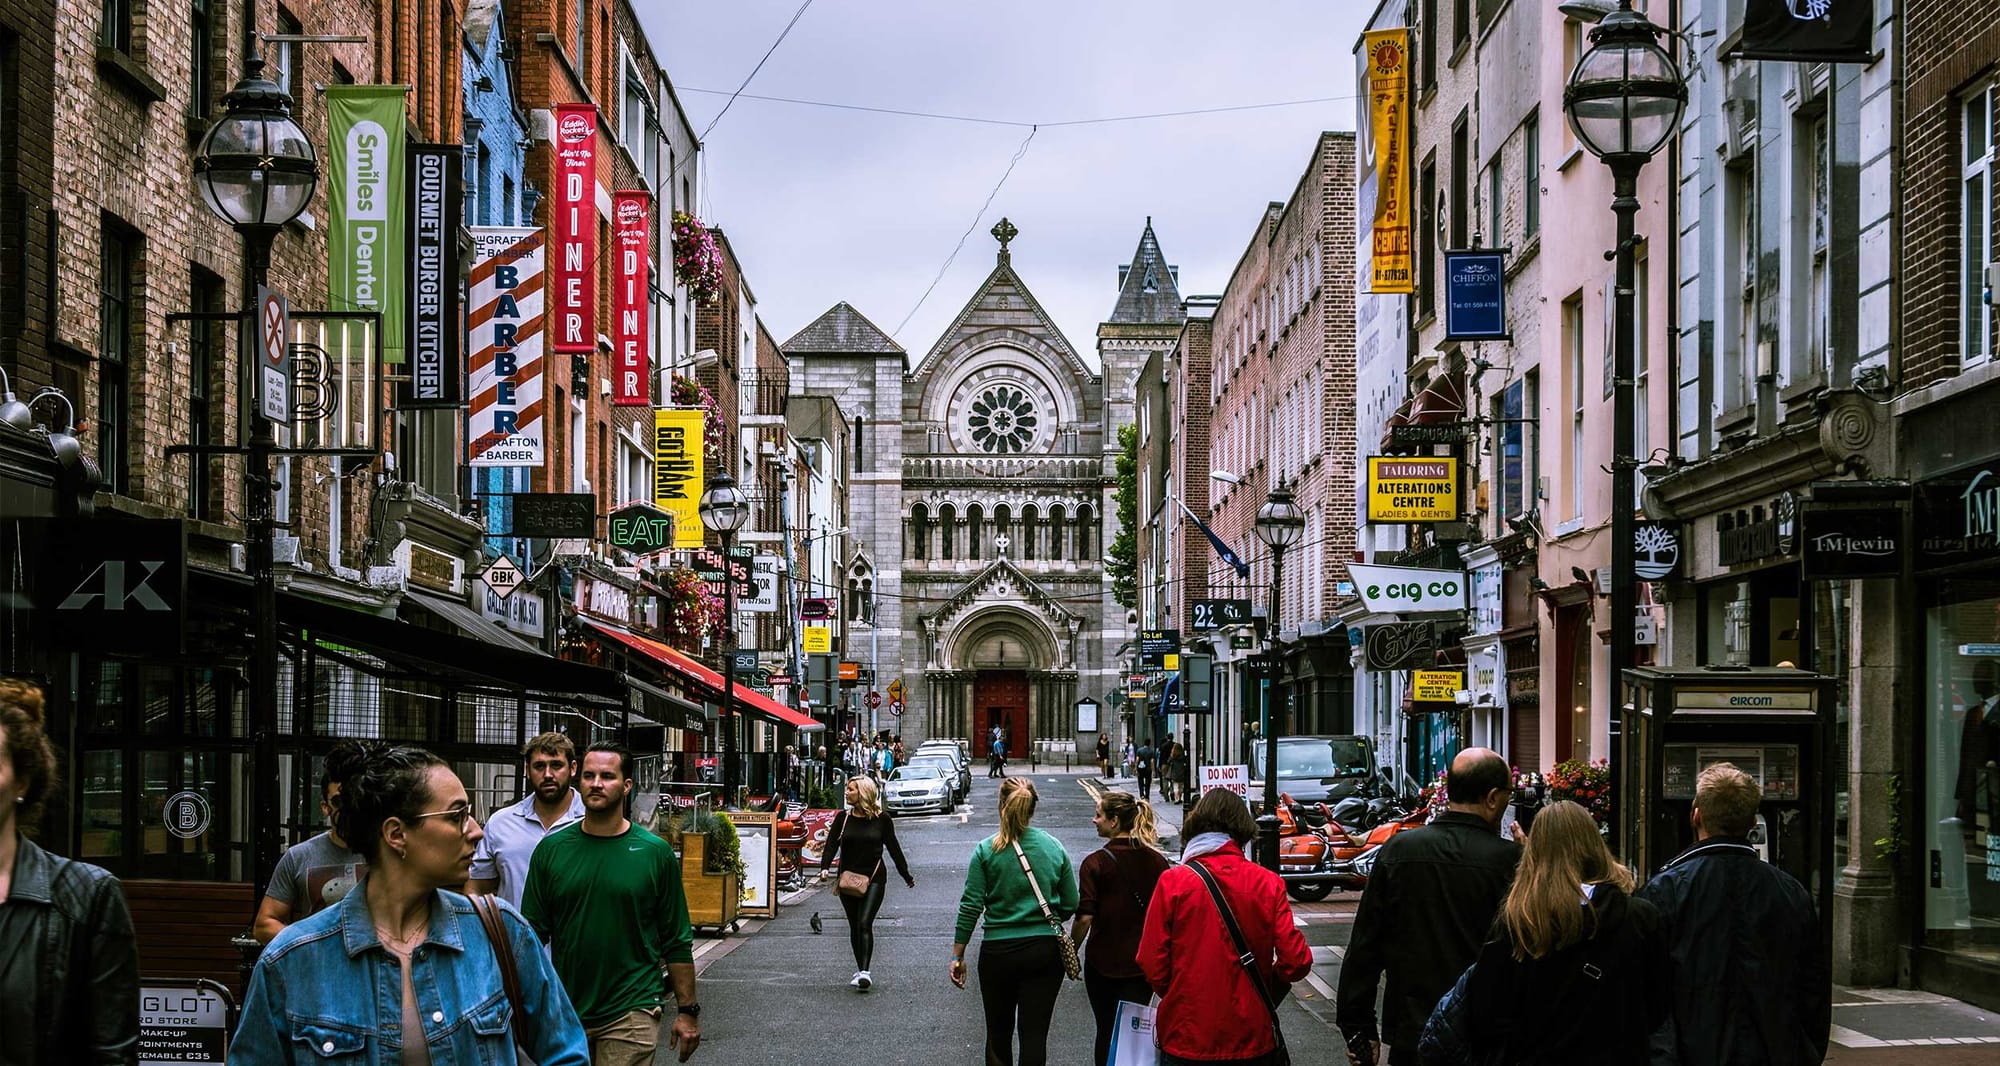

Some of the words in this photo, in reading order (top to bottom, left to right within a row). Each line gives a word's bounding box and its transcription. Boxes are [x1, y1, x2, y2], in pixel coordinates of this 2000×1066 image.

[564, 120, 585, 128] Eddie
[1386, 103, 1399, 223] ALTERATION
[356, 133, 378, 212] Smiles
[418, 154, 440, 240] GOURMET
[476, 235, 486, 256] THE
[486, 236, 539, 246] GRAFTON
[1376, 230, 1408, 252] CENTRE
[487, 249, 534, 258] BARBER
[565, 173, 583, 343] DINER
[355, 226, 378, 306] Dental
[418, 244, 440, 315] BURGER
[1453, 274, 1497, 283] CHIFFON
[623, 250, 638, 397] DINER
[493, 265, 520, 435] BARBER
[418, 321, 439, 400] KITCHEN
[1397, 427, 1462, 441] RESTAURANT
[485, 438, 538, 447] GRAFTON
[487, 450, 534, 460] BARBER
[657, 427, 698, 500] GOTHAM
[1384, 465, 1444, 477] TAILORING
[1377, 483, 1452, 495] ALTERATIONS
[1393, 497, 1435, 508] CENTRE
[525, 517, 584, 528] BARBER
[613, 516, 668, 546] EAT
[727, 547, 751, 557] INES
[491, 571, 514, 583] GBK
[698, 571, 725, 580] SPIRITS
[56, 560, 172, 611] AK
[1367, 584, 1381, 600] e
[1386, 583, 1422, 603] cig
[1428, 581, 1458, 598] co
[513, 597, 518, 621] @
[529, 600, 537, 626] SIX
[864, 696, 880, 704] SOP
[1208, 768, 1219, 780] DO
[1222, 767, 1238, 779] NOT
[1227, 784, 1246, 795] THIS
[179, 802, 198, 828] B
[143, 997, 216, 1013] GLOT
[158, 1017, 197, 1025] STORE
[138, 1041, 203, 1049] POINTMENTS
